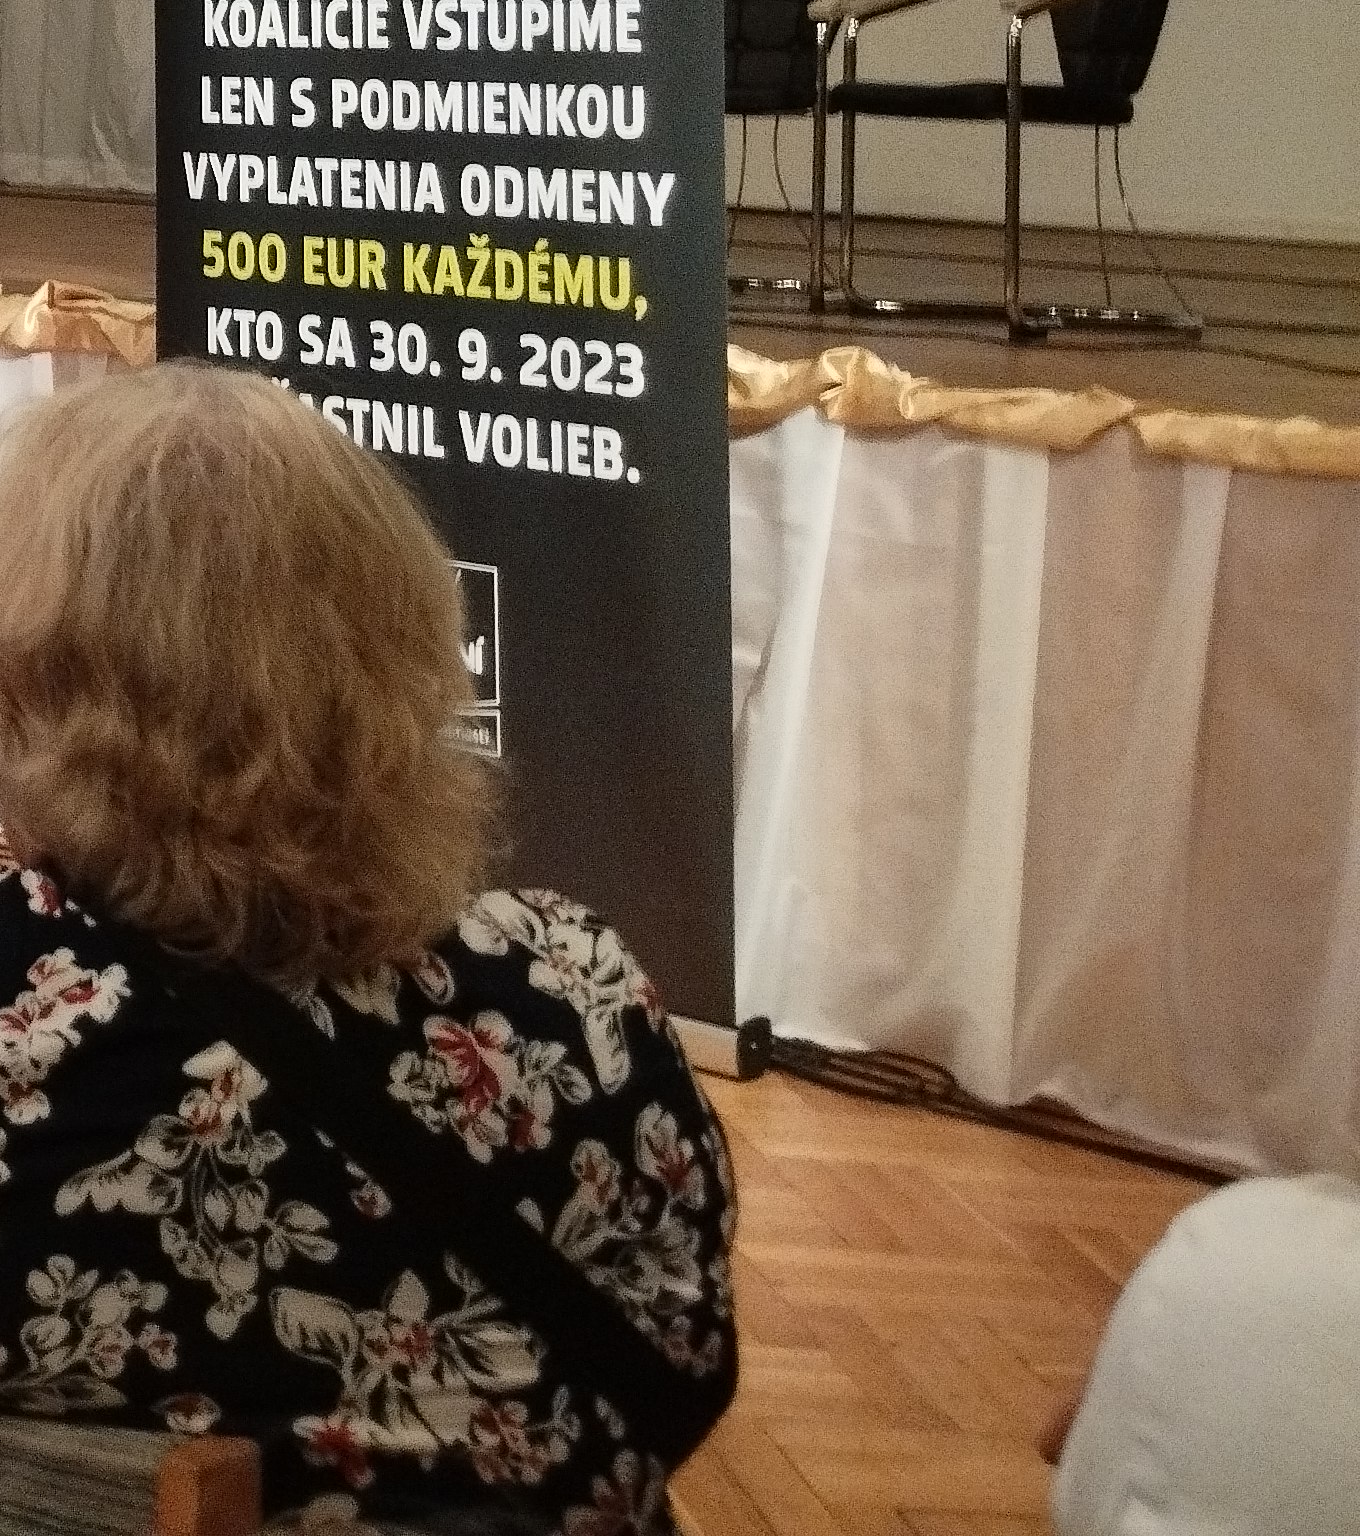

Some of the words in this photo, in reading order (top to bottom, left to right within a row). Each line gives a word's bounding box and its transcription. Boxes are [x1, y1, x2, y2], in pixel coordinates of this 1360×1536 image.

[201, 75, 274, 126] LEN
[289, 77, 316, 128] S
[331, 78, 646, 140] PODMIENKOU
[182, 151, 445, 214] VYPLATENIA
[460, 163, 676, 227] ODMENY
[203, 229, 286, 283] 500
[303, 235, 387, 291] EUR
[402, 233, 648, 321] KAŽDÉMU,
[207, 306, 283, 361] KTO
[298, 314, 356, 369] SA
[369, 320, 441, 378] 30.
[458, 328, 503, 384] 9.
[519, 333, 646, 398] 2023
[459, 410, 641, 484] VOLIEB.
